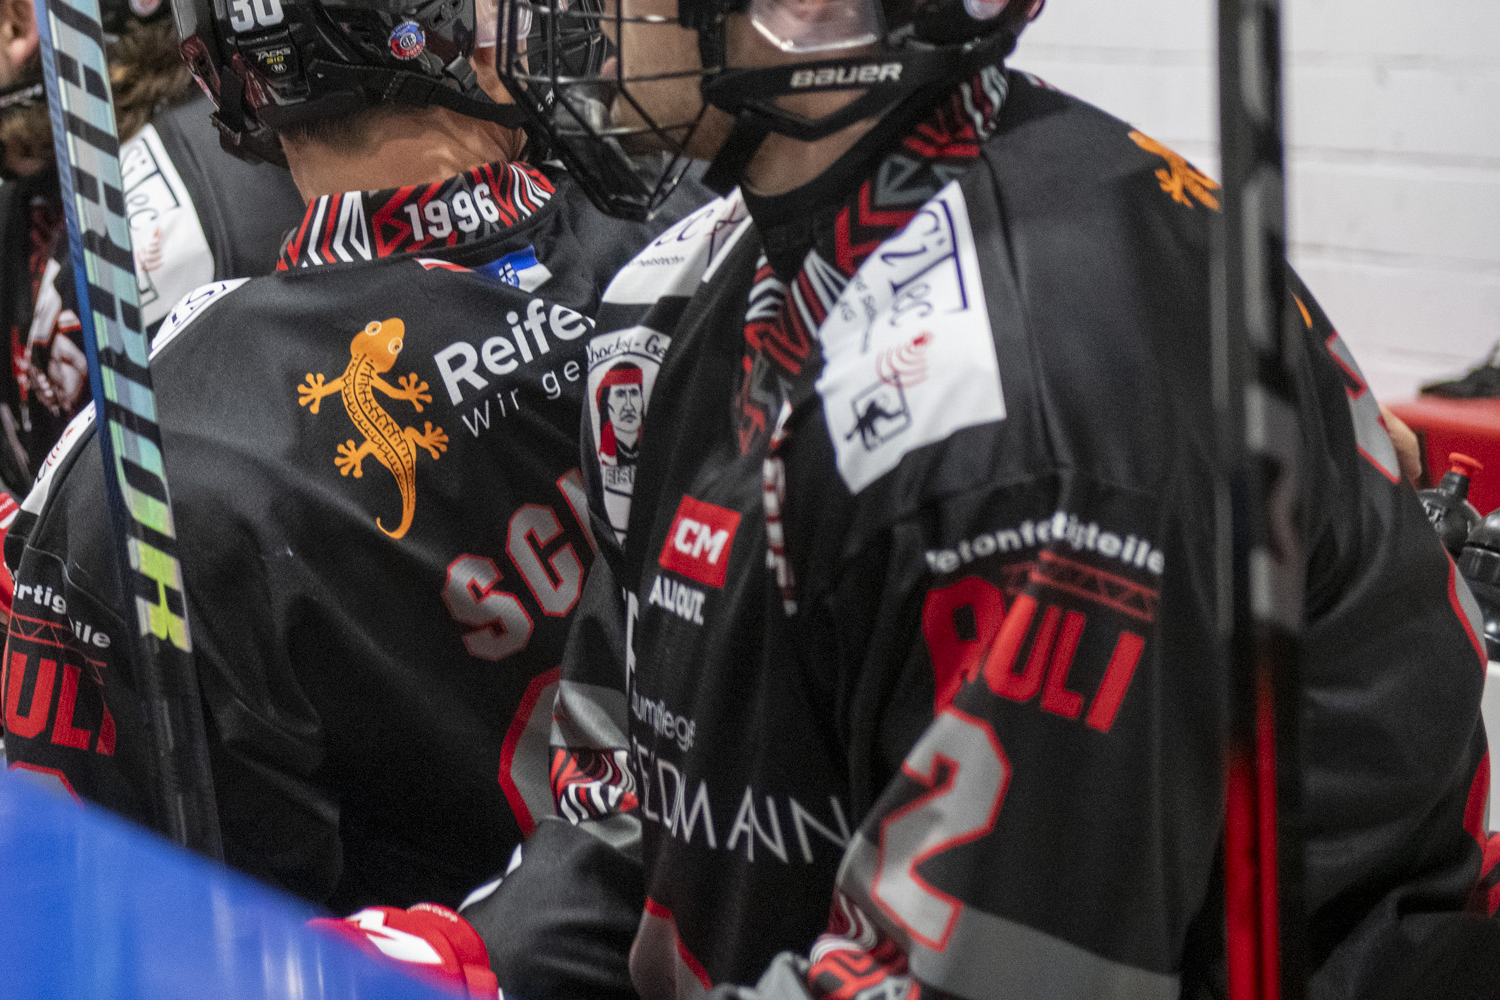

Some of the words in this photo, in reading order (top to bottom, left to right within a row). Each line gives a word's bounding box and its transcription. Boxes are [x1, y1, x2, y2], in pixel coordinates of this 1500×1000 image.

[404, 183, 499, 241] 1996
[434, 298, 595, 406] Reife
[462, 388, 520, 438] Wir
[542, 360, 581, 399] ge
[870, 704, 1013, 953] 2
